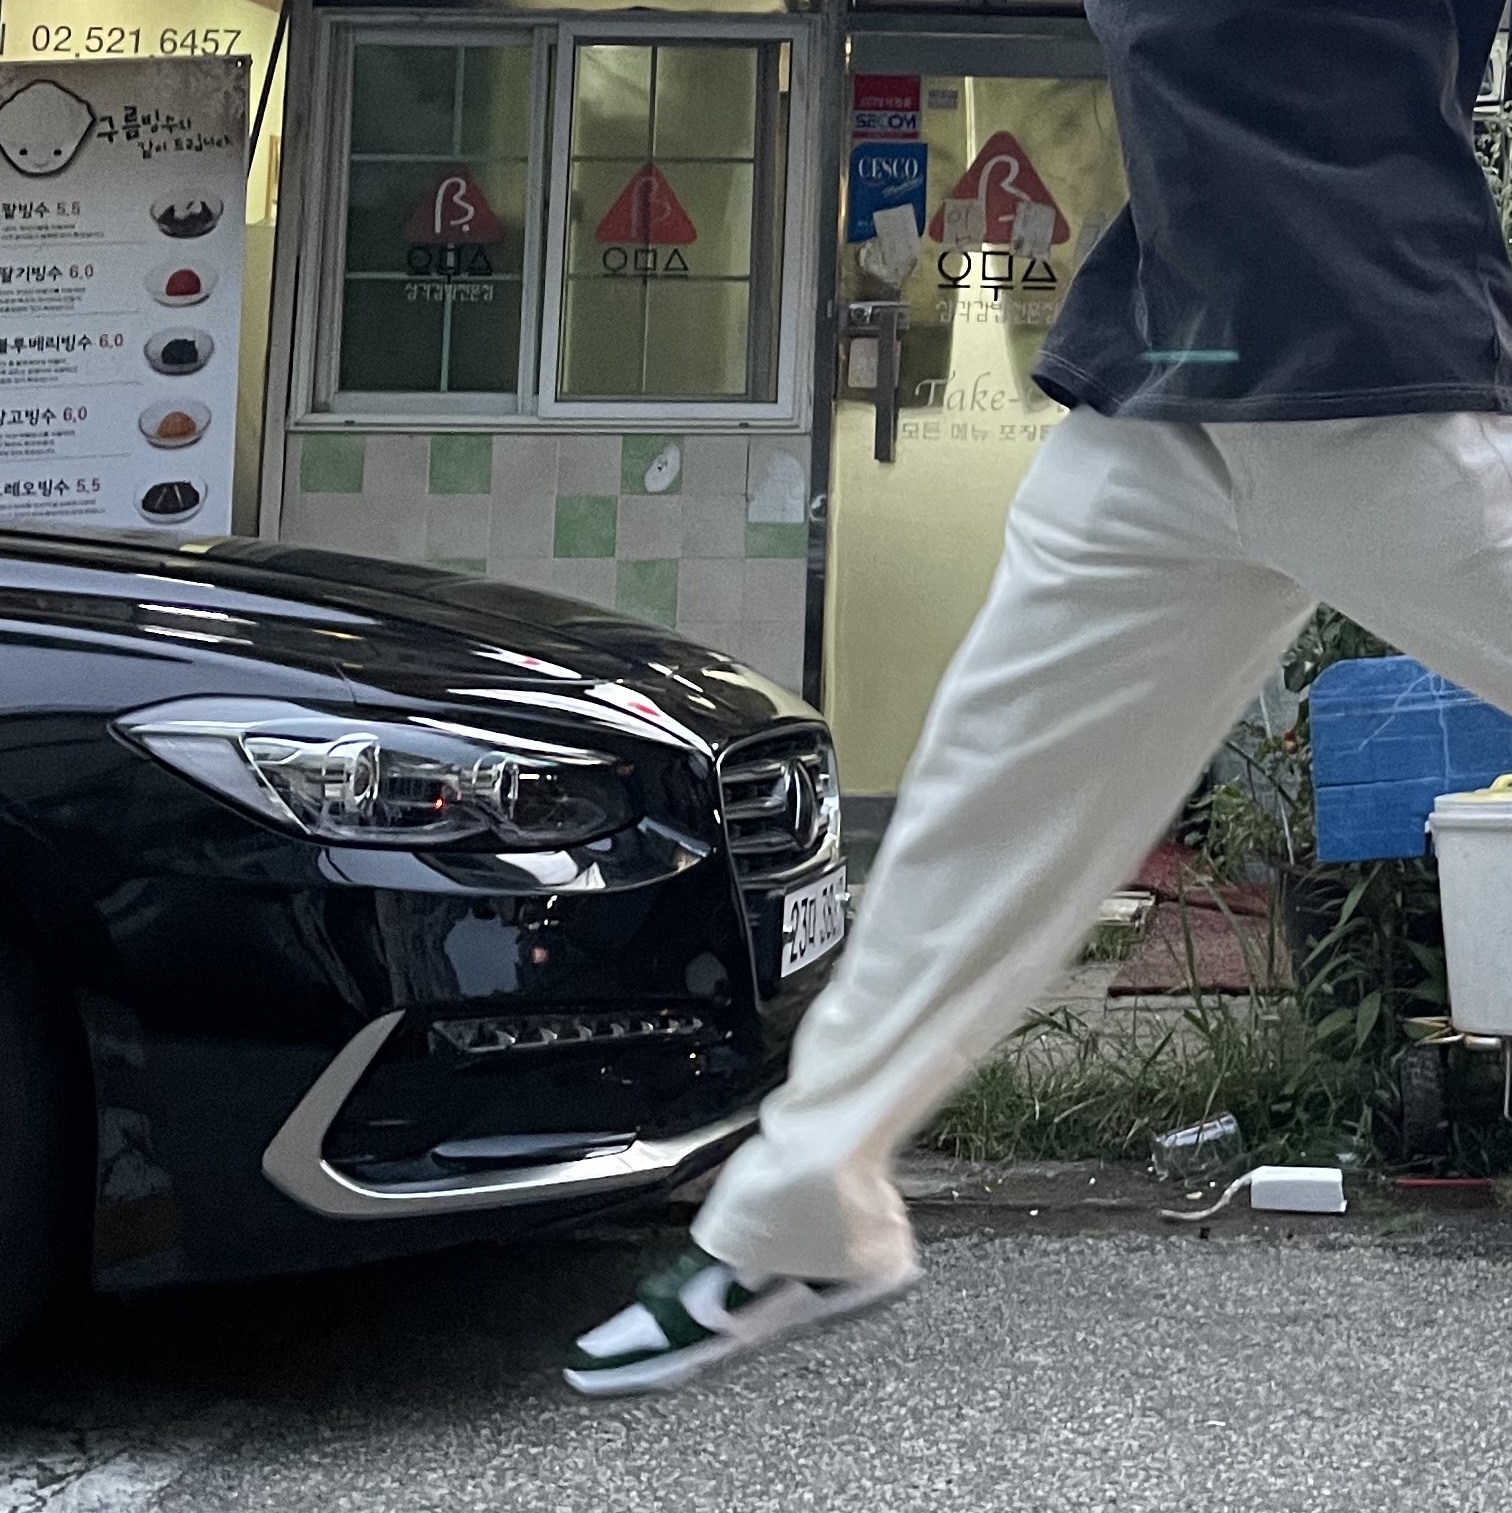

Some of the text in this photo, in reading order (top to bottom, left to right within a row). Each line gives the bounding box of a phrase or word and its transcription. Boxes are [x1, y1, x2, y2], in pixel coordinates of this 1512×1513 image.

[856, 112, 917, 130] SECOM
[857, 156, 919, 179] CESCO
[0, 479, 70, 497] 레오빙수
